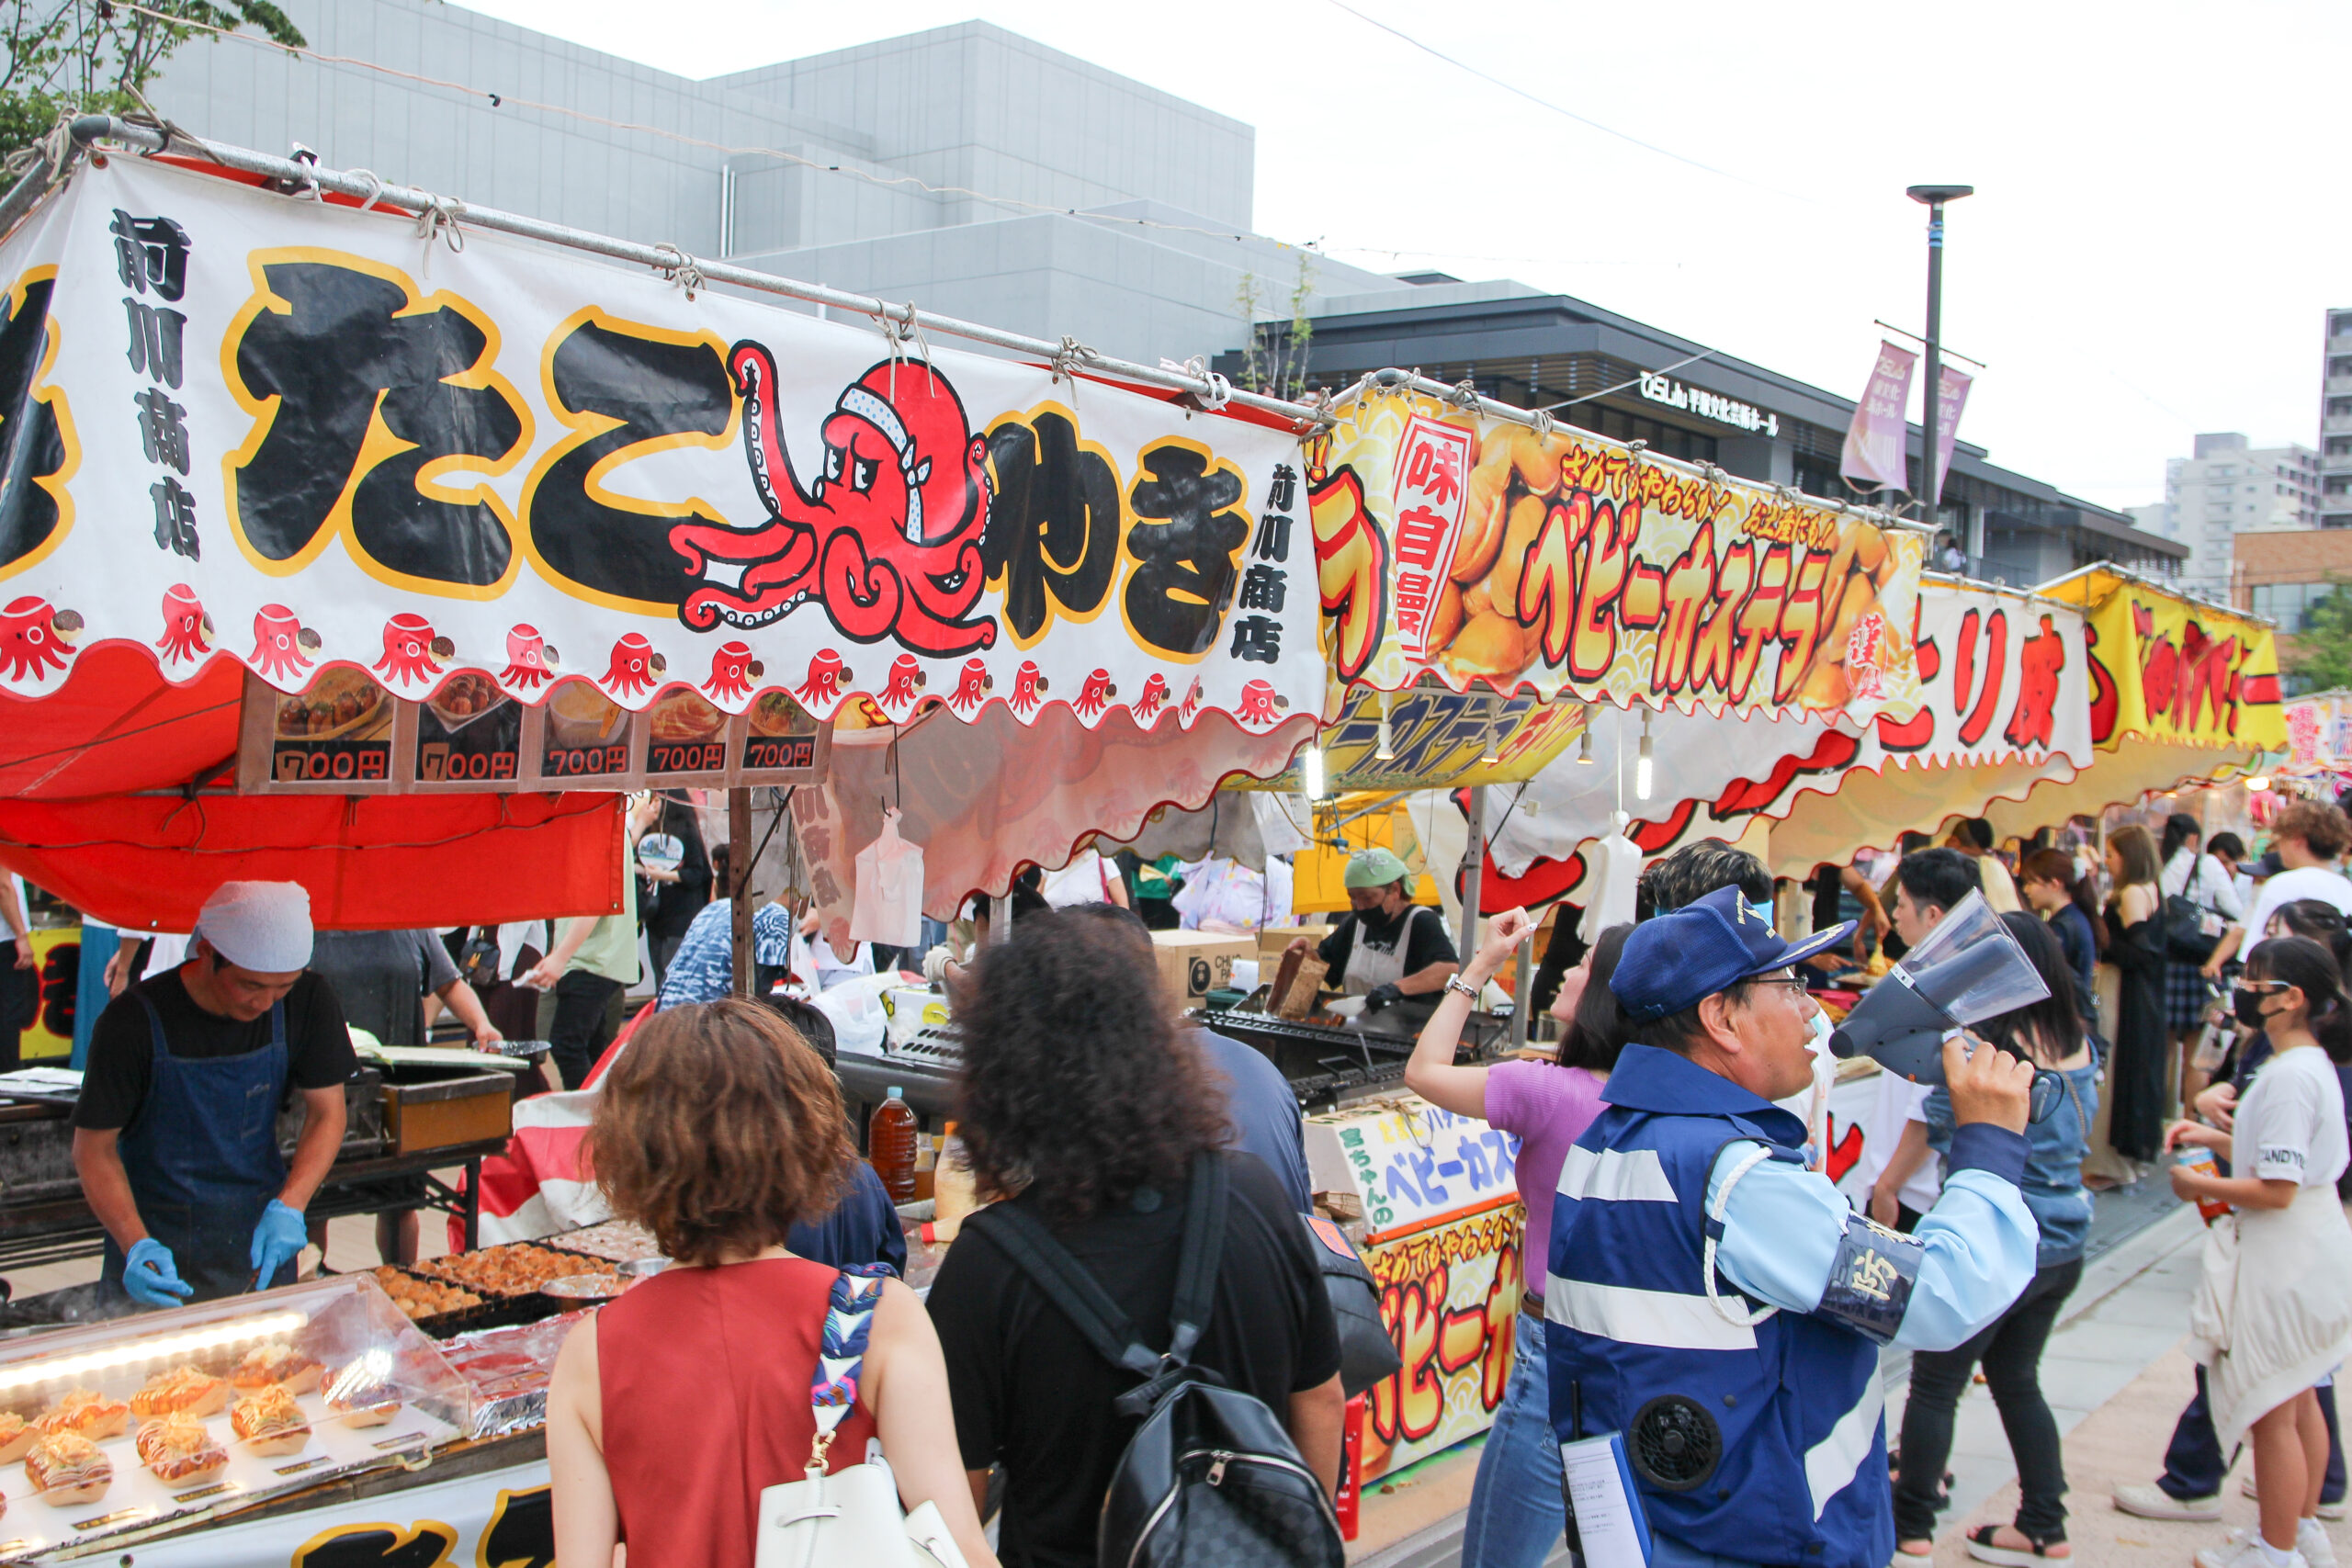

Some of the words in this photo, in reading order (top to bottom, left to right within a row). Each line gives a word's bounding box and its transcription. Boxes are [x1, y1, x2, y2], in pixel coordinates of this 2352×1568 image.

[109, 208, 201, 562] 前川商店
[1230, 463, 1298, 665] 前川商店
[1515, 492, 1833, 707] ベビーカステラ
[279, 750, 386, 781] 700円
[426, 750, 515, 781] 700円
[548, 745, 628, 775] 700円
[653, 743, 726, 772] 700円
[750, 742, 812, 769] 700円
